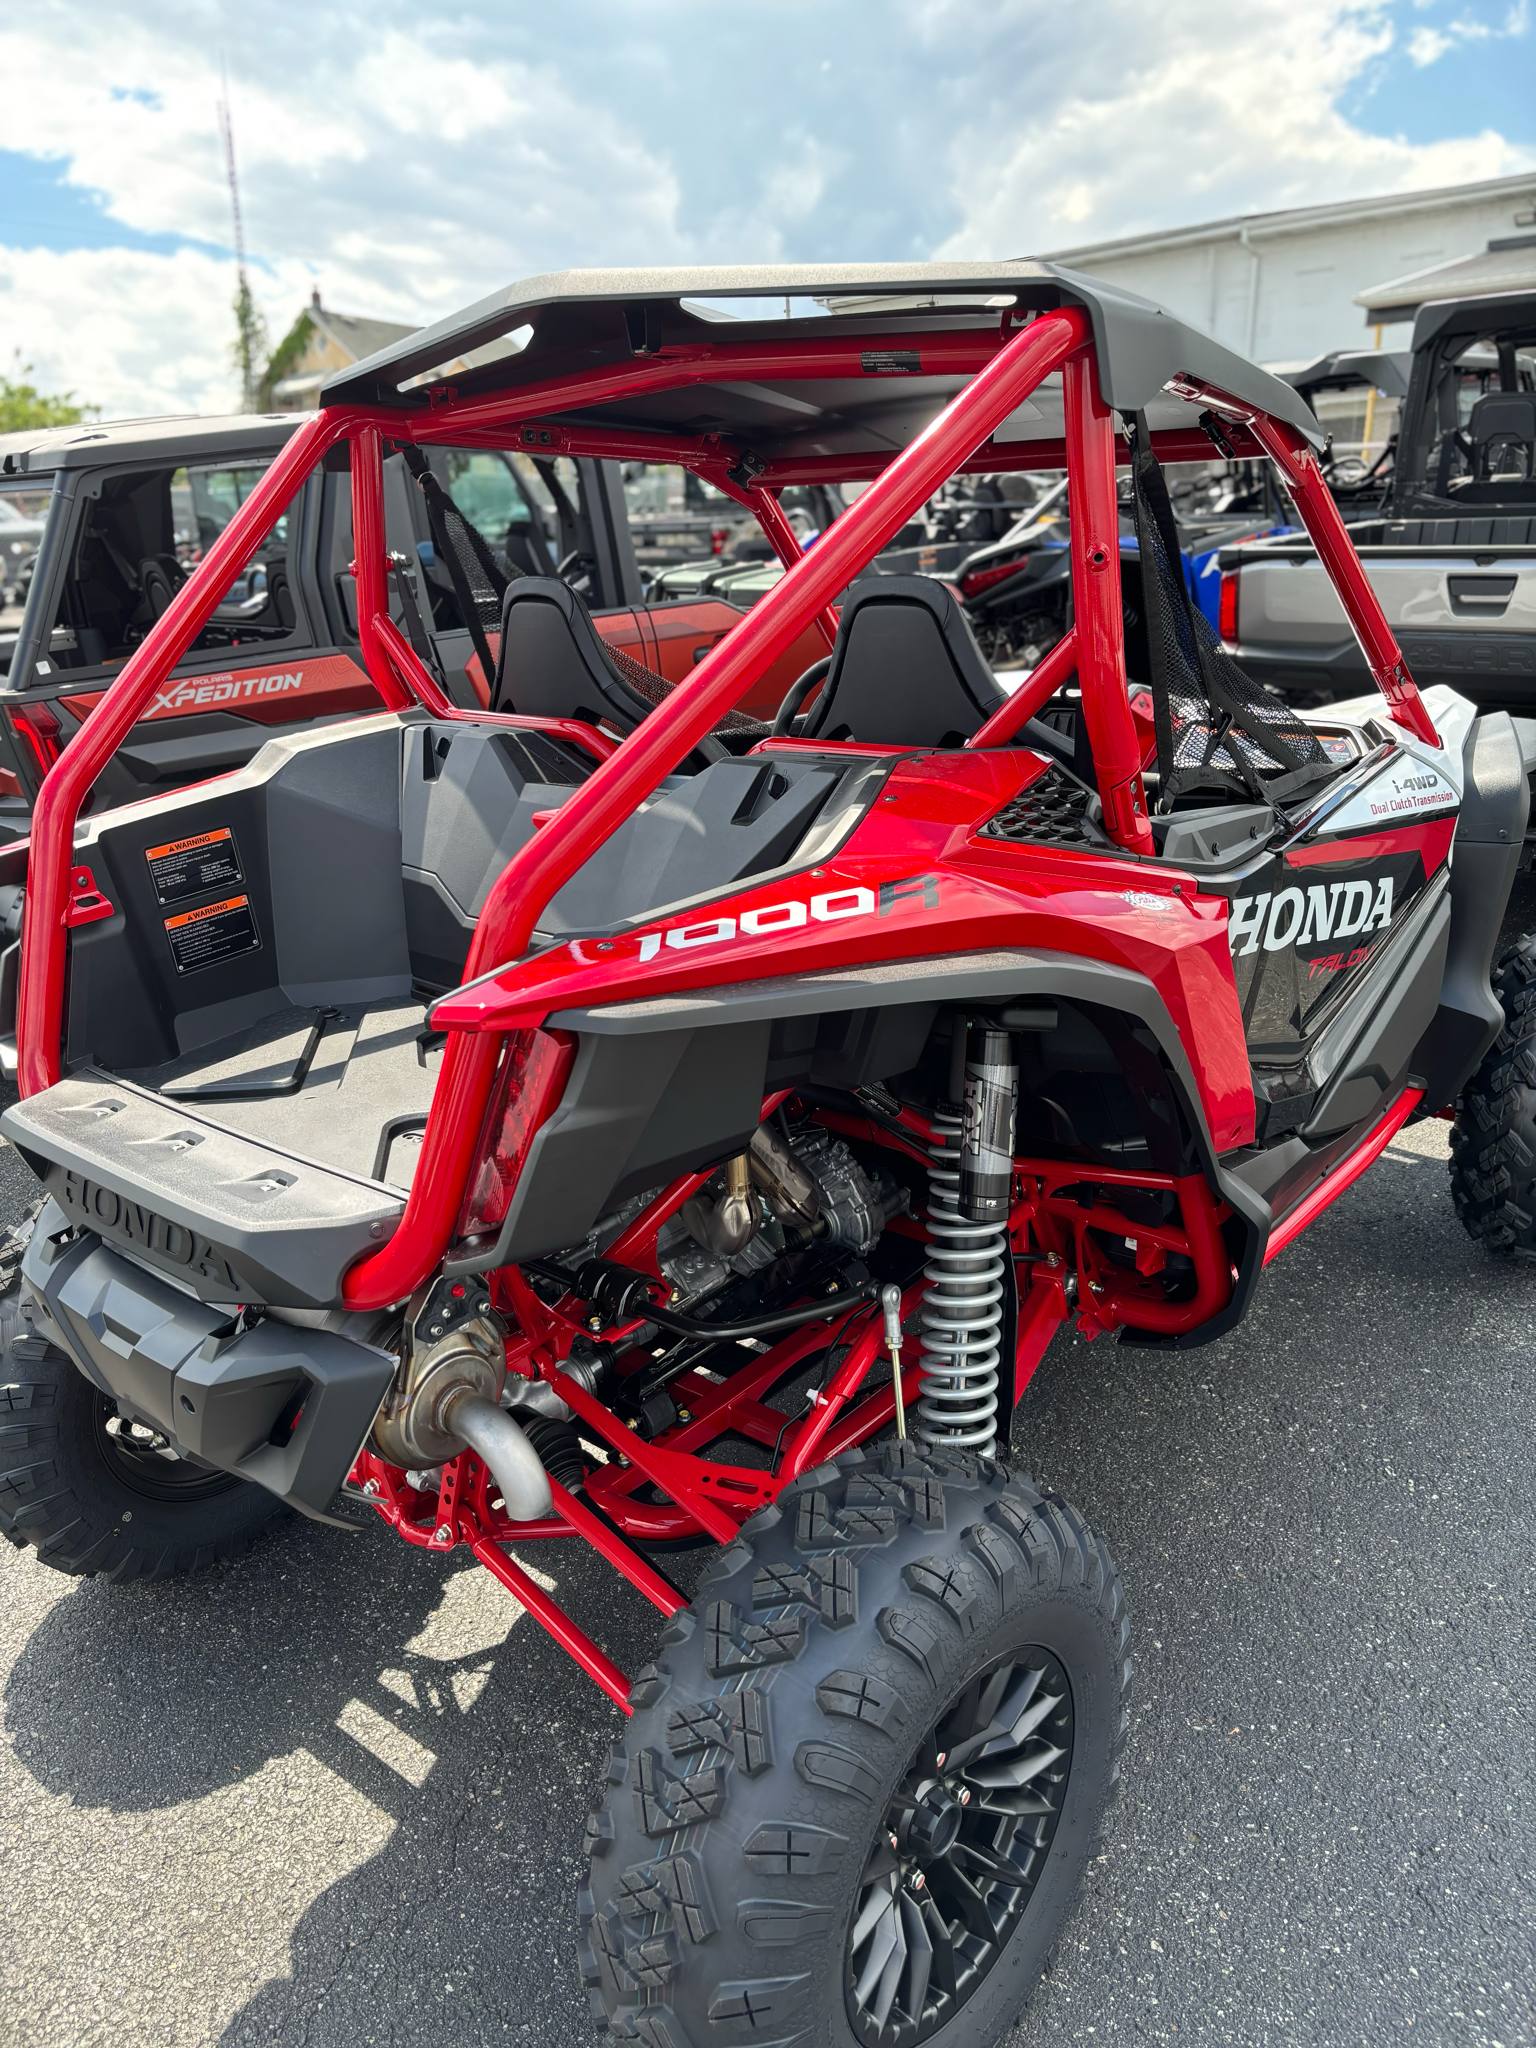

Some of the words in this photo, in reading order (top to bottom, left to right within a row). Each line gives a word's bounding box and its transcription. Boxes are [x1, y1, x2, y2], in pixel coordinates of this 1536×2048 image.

[192, 674, 233, 686] POLARIS
[141, 672, 304, 719] XPEDITION
[1392, 774, 1438, 794] i-4WD
[1370, 801, 1389, 815] Dual
[1390, 797, 1412, 811] Clutch
[1411, 791, 1453, 807] Transmission
[174, 835, 210, 850] WARNING
[192, 903, 228, 919] WARNING
[634, 874, 940, 962] 1000R
[1228, 876, 1394, 957] HONDA
[1308, 945, 1376, 980] TALON
[63, 1169, 240, 1292] HONDA
